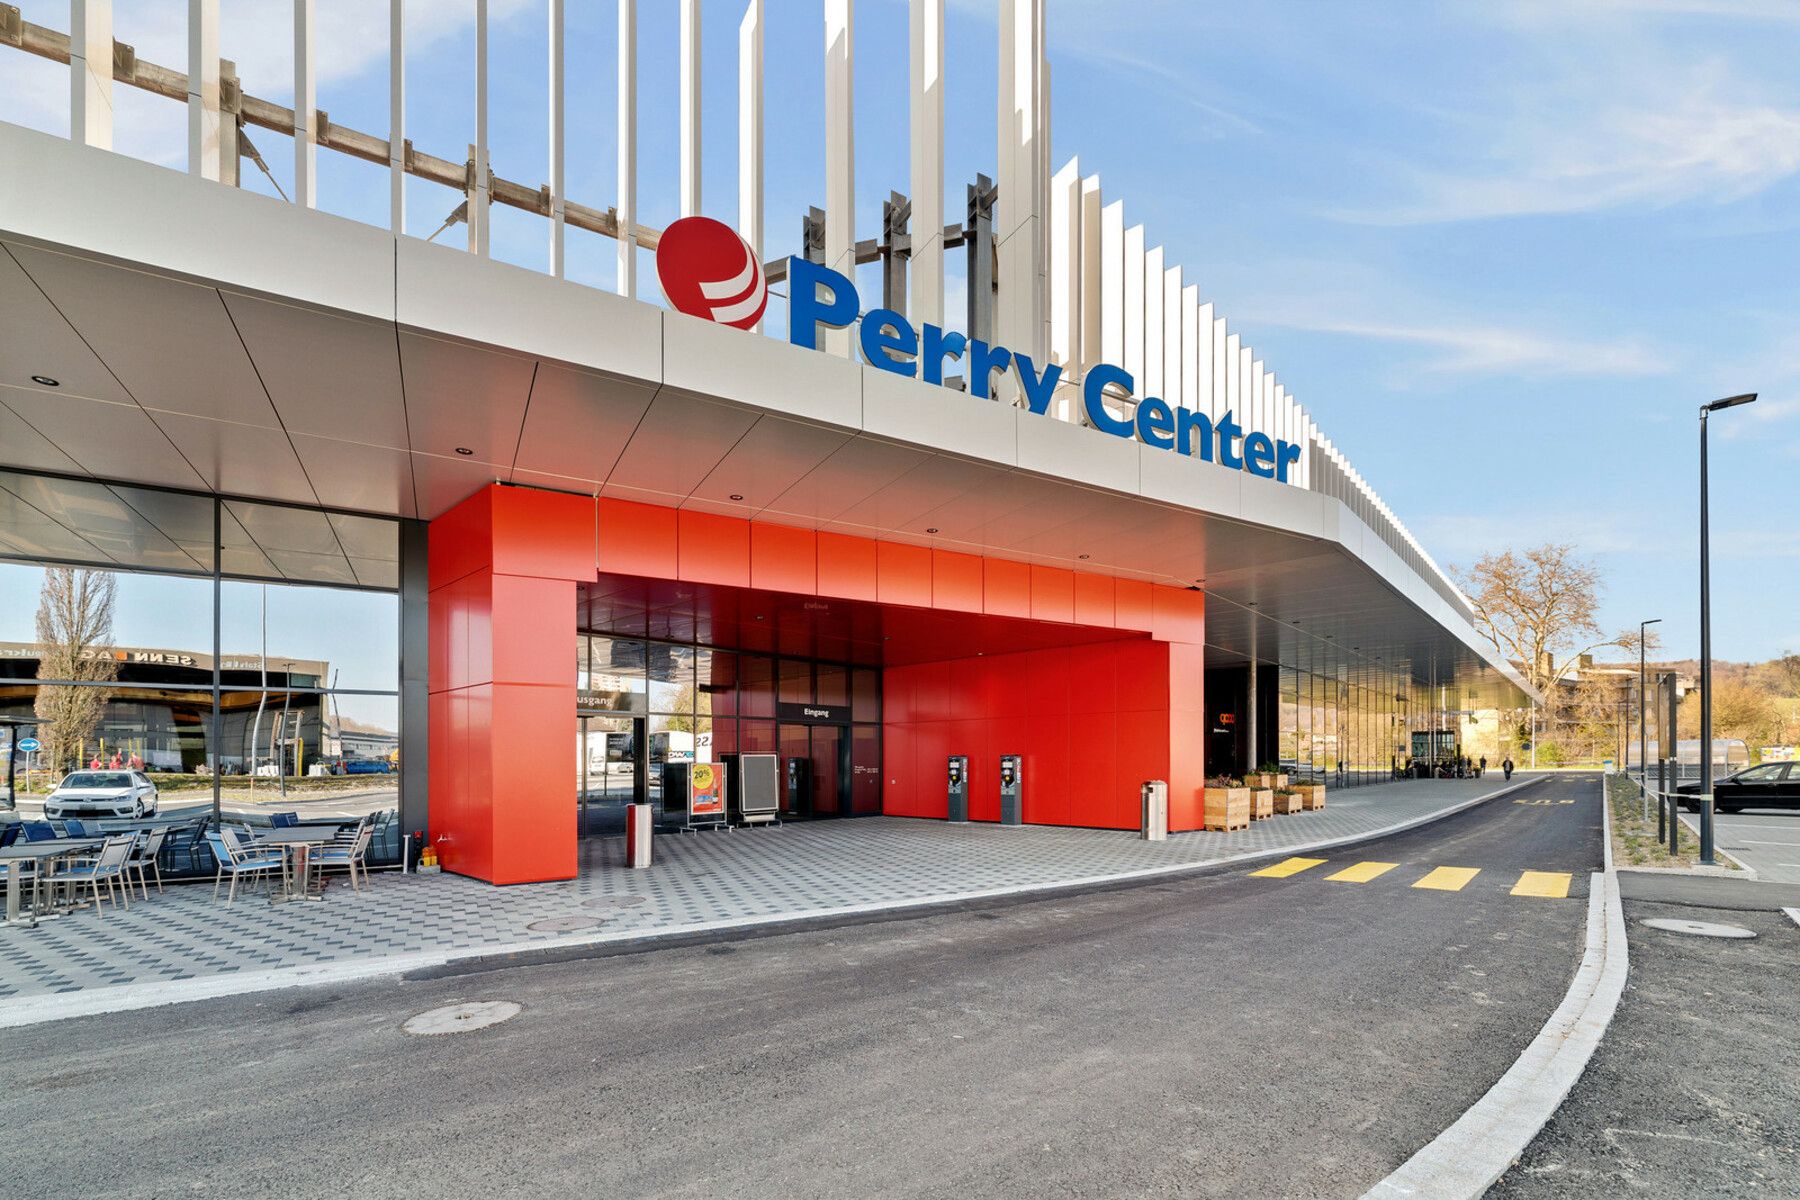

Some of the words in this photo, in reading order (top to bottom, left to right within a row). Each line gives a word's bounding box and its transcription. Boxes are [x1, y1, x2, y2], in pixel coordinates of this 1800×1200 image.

[789, 256, 1061, 414] Perry
[1083, 363, 1301, 482] Center
[577, 696, 614, 706] usgang
[803, 708, 829, 718] Eingang
